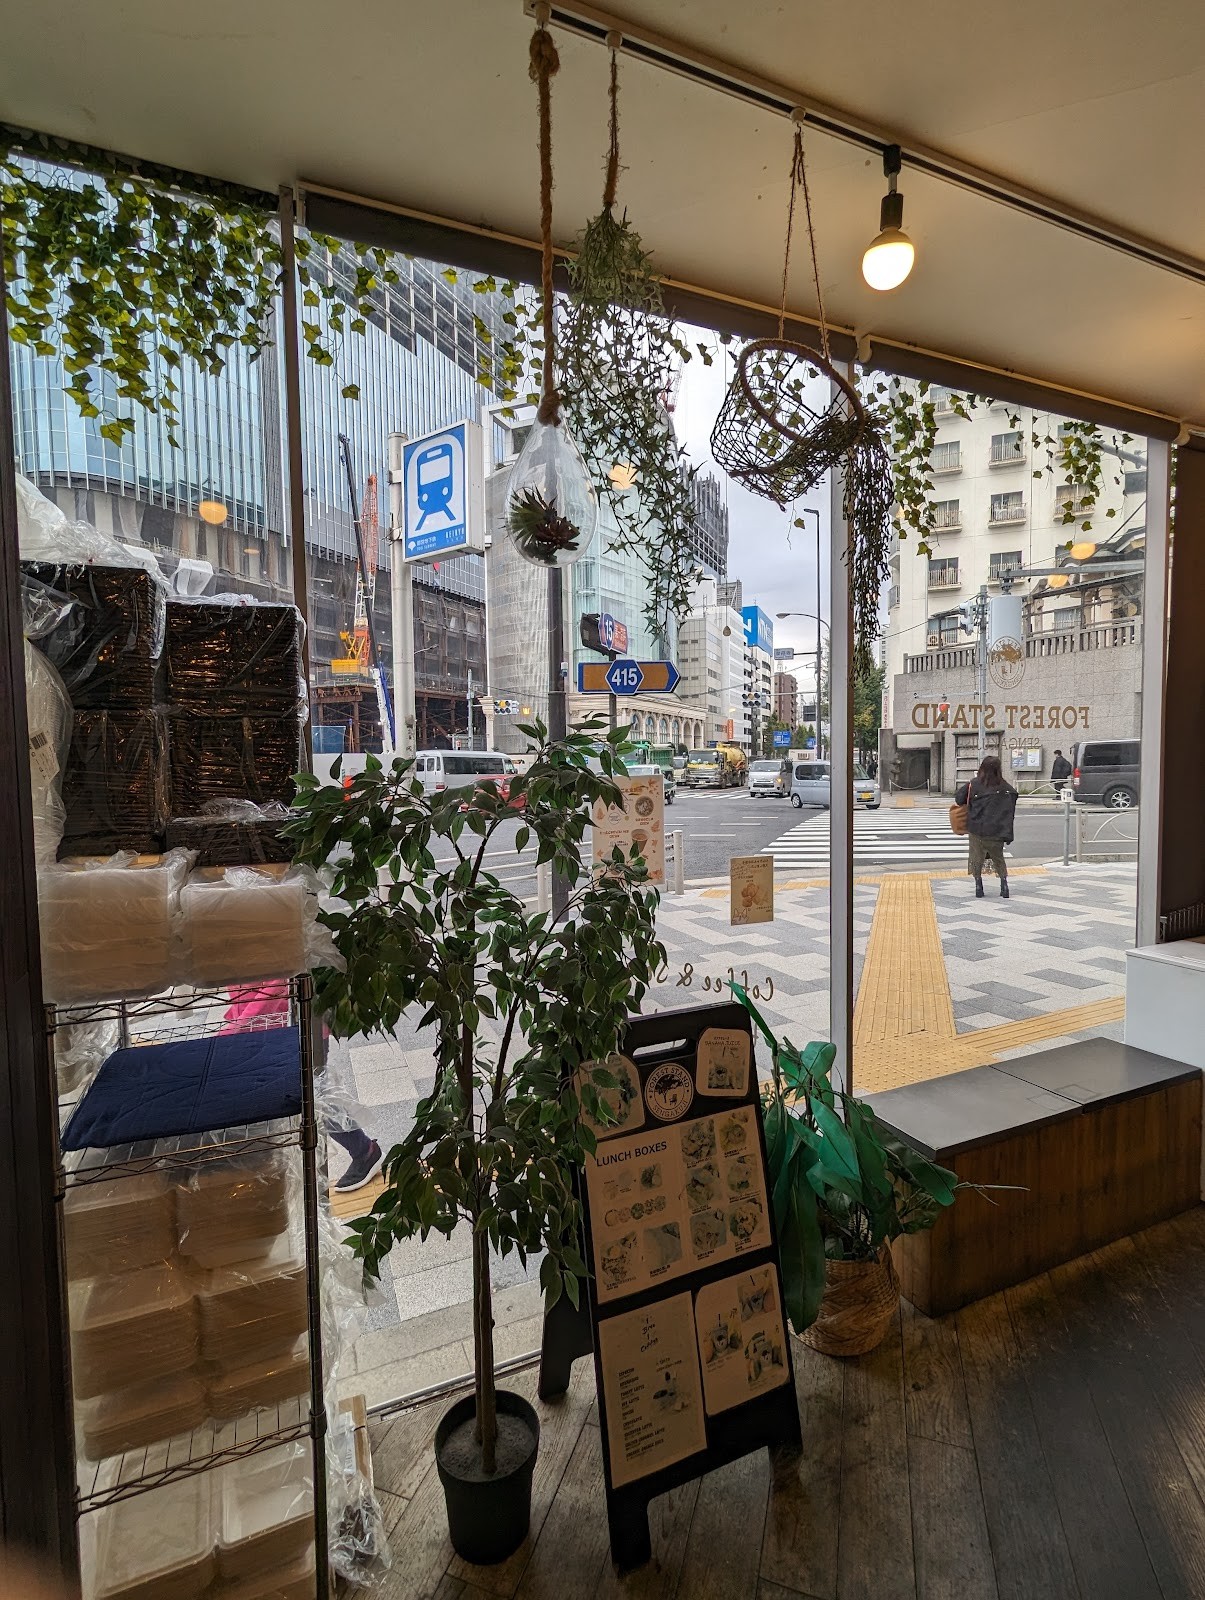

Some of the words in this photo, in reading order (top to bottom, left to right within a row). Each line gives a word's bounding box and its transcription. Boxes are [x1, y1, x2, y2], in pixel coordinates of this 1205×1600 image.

[605, 619, 613, 641] 15
[611, 667, 638, 686] 415
[649, 1067, 669, 1093] FOREST
[670, 1067, 690, 1088] STAND
[596, 1150, 632, 1167] LUNCH
[634, 1141, 668, 1158] BOXES
